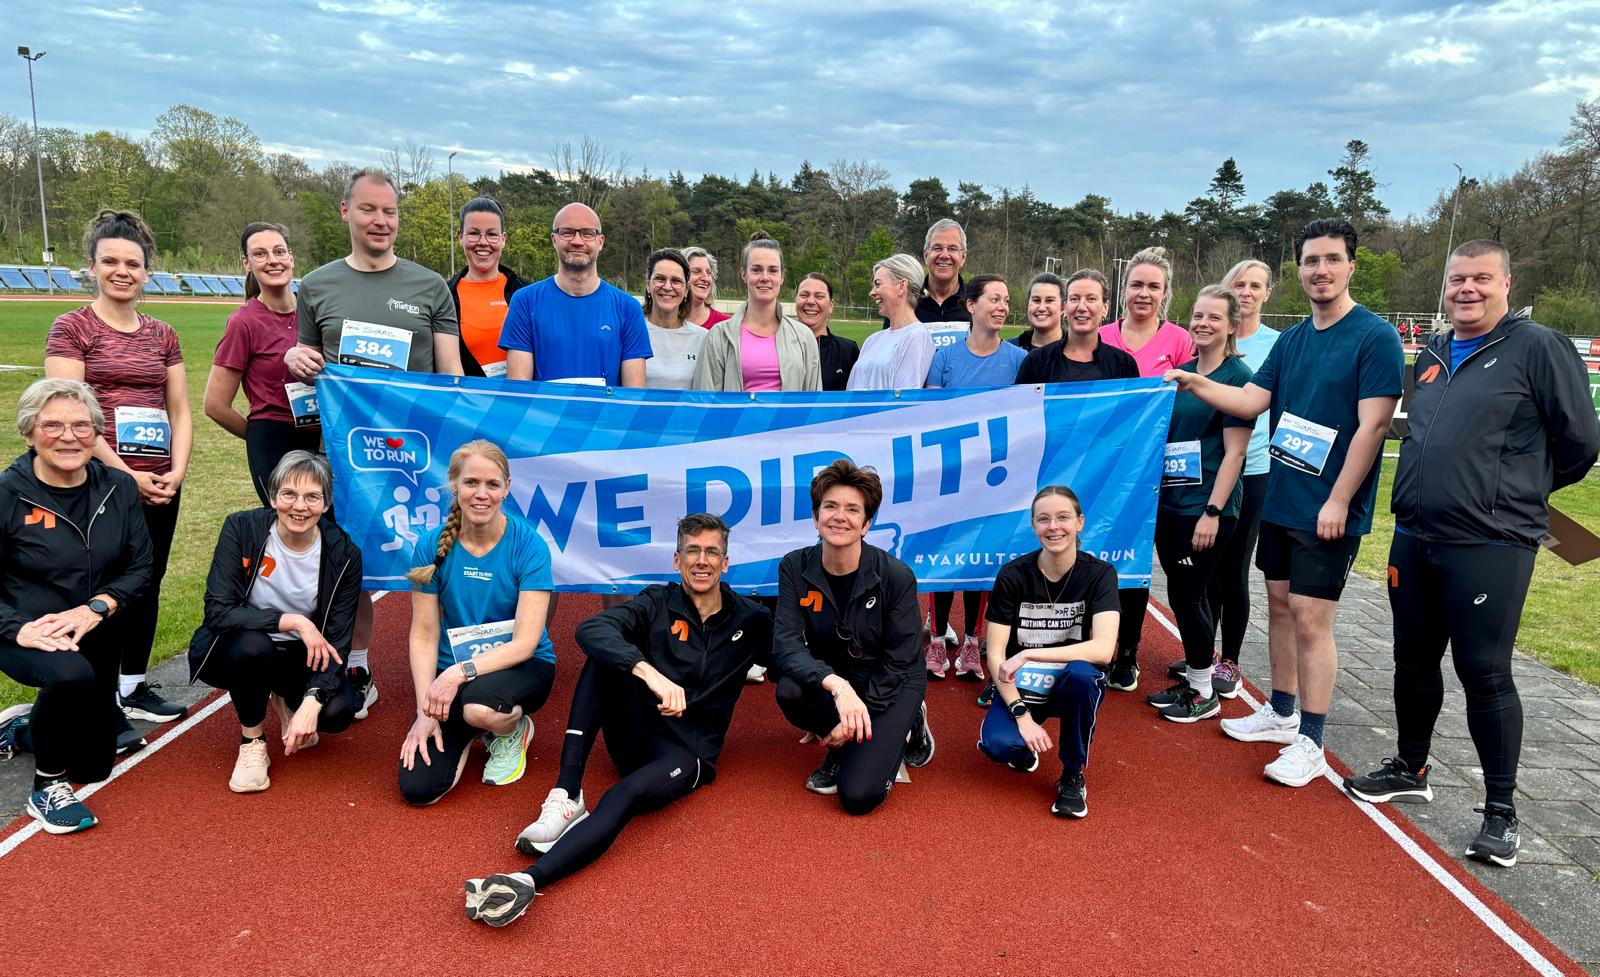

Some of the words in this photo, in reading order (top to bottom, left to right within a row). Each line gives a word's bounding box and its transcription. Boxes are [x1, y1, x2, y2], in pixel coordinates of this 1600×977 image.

[355, 340, 393, 357] 384
[933, 336, 956, 346] 391
[134, 427, 164, 442] 292
[363, 436, 385, 448] WE
[1282, 433, 1314, 455] 297
[364, 449, 384, 461] TO
[386, 450, 416, 464] RUN
[1165, 458, 1187, 472] 293
[502, 473, 651, 554] WE
[892, 416, 1008, 504] IT!
[1021, 619, 1046, 628] NOTHING
[1047, 619, 1060, 628] CAN
[1060, 619, 1074, 628] STOP
[1020, 672, 1055, 688] 379
